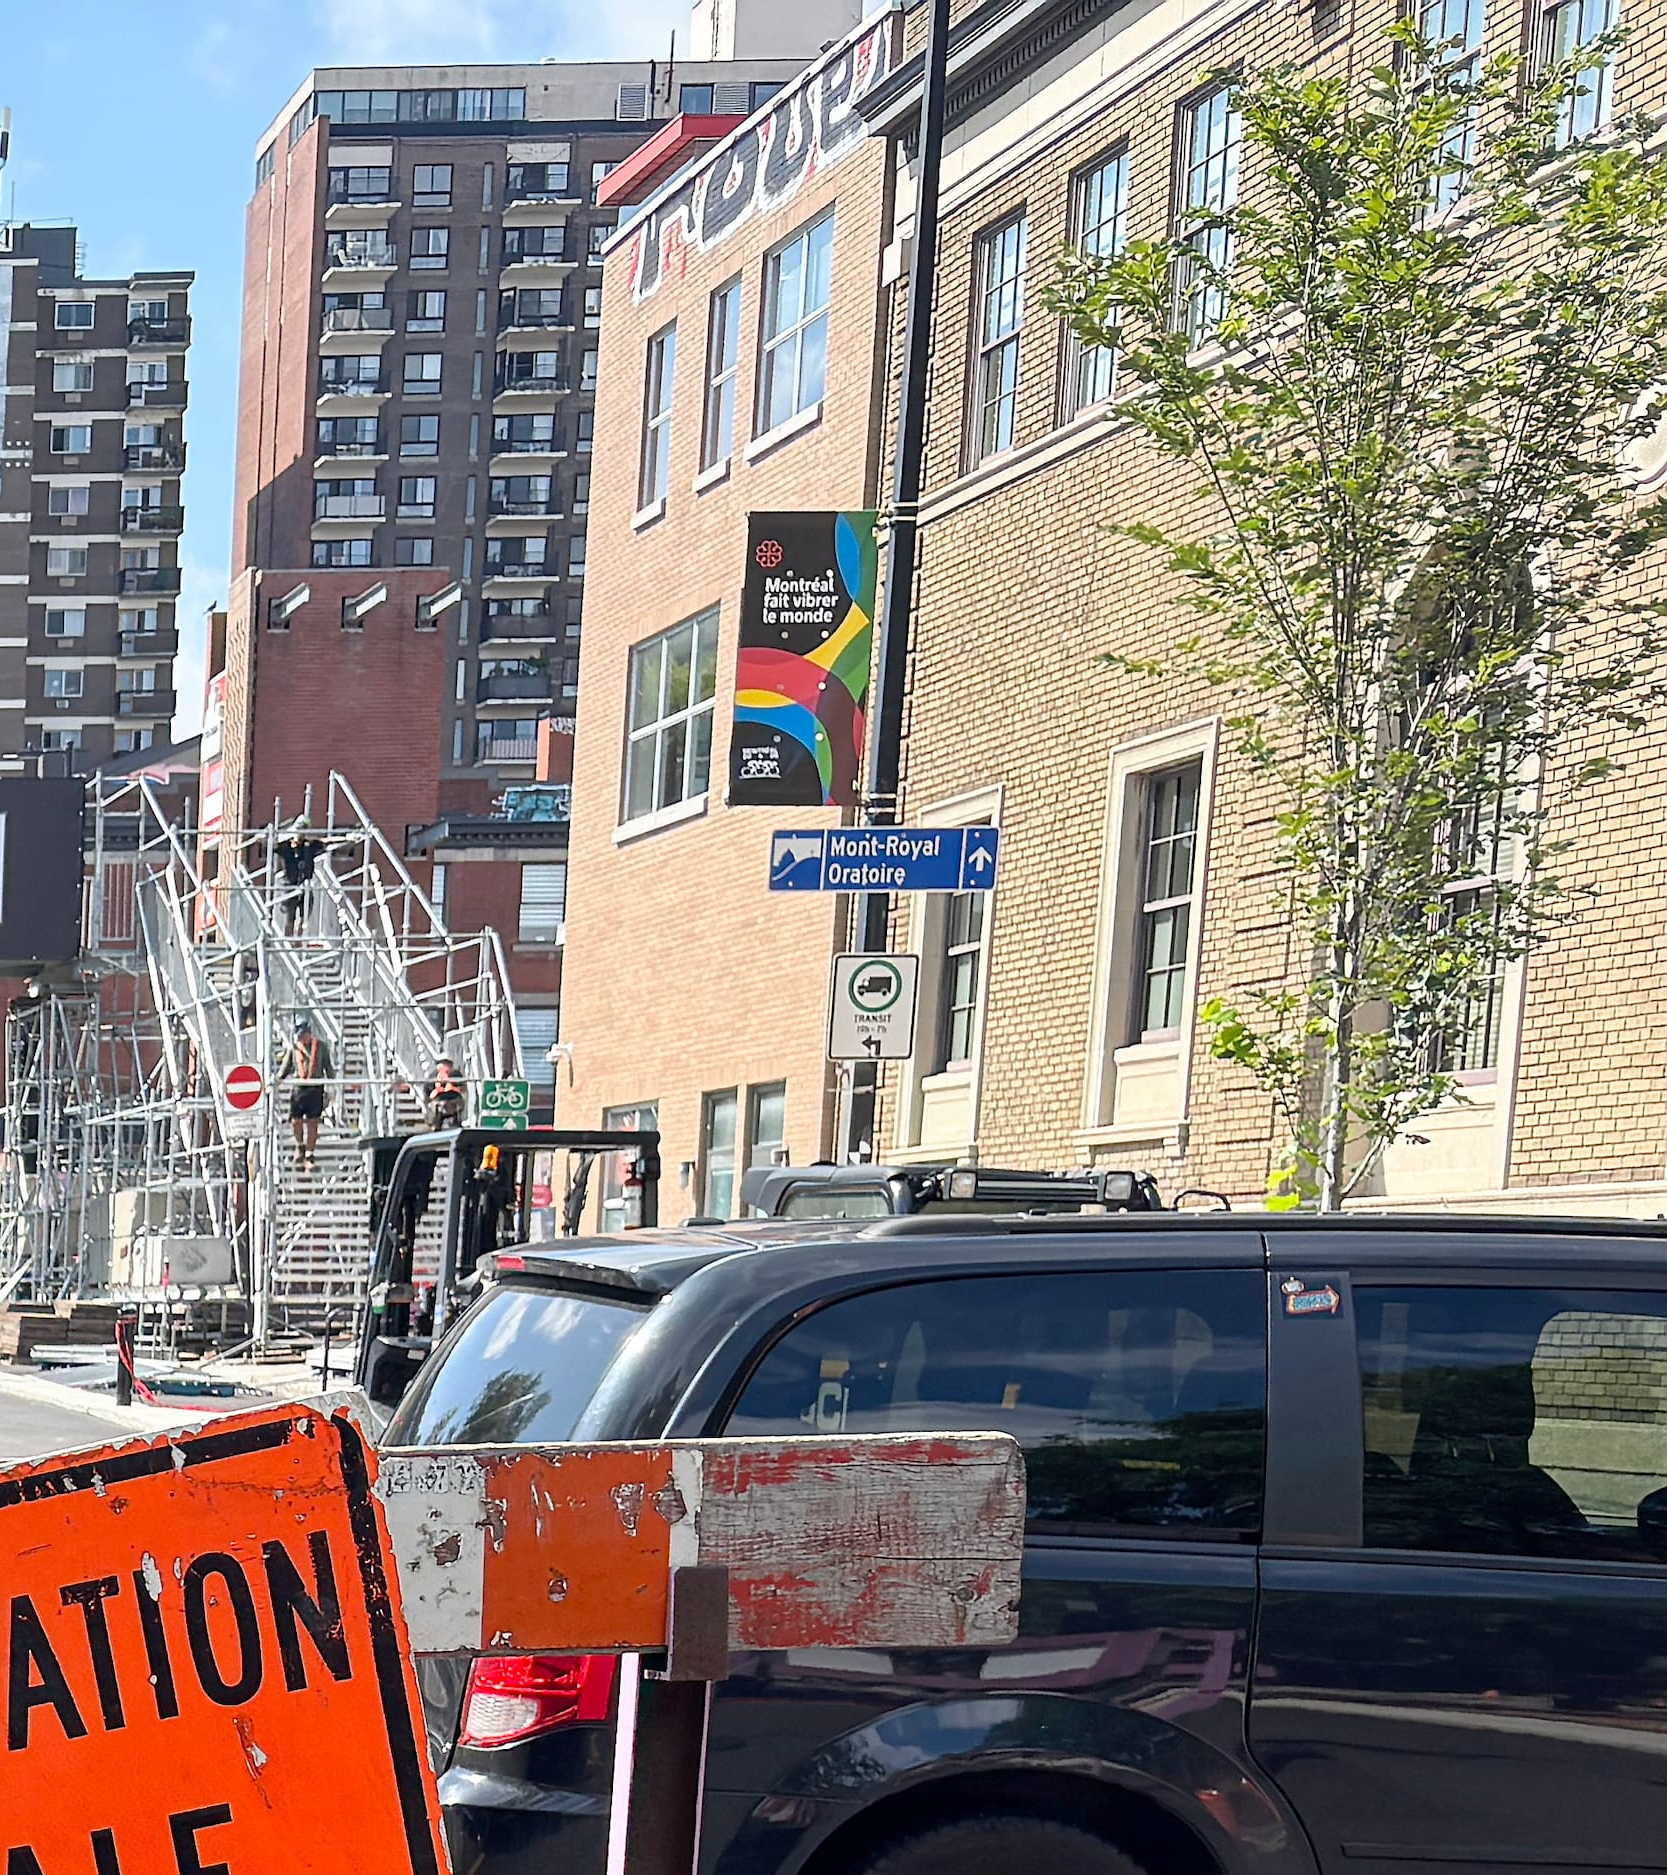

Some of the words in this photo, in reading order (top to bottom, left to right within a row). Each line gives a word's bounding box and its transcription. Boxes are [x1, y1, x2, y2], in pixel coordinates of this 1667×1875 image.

[765, 576, 835, 594] Montréal
[763, 593, 790, 609] fait
[792, 592, 839, 608] vibrer
[763, 607, 777, 624] le
[779, 609, 833, 623] monde
[830, 834, 941, 861] Mont-Royal
[828, 862, 906, 885] Oratoire
[854, 1014, 892, 1023] TRANSIT
